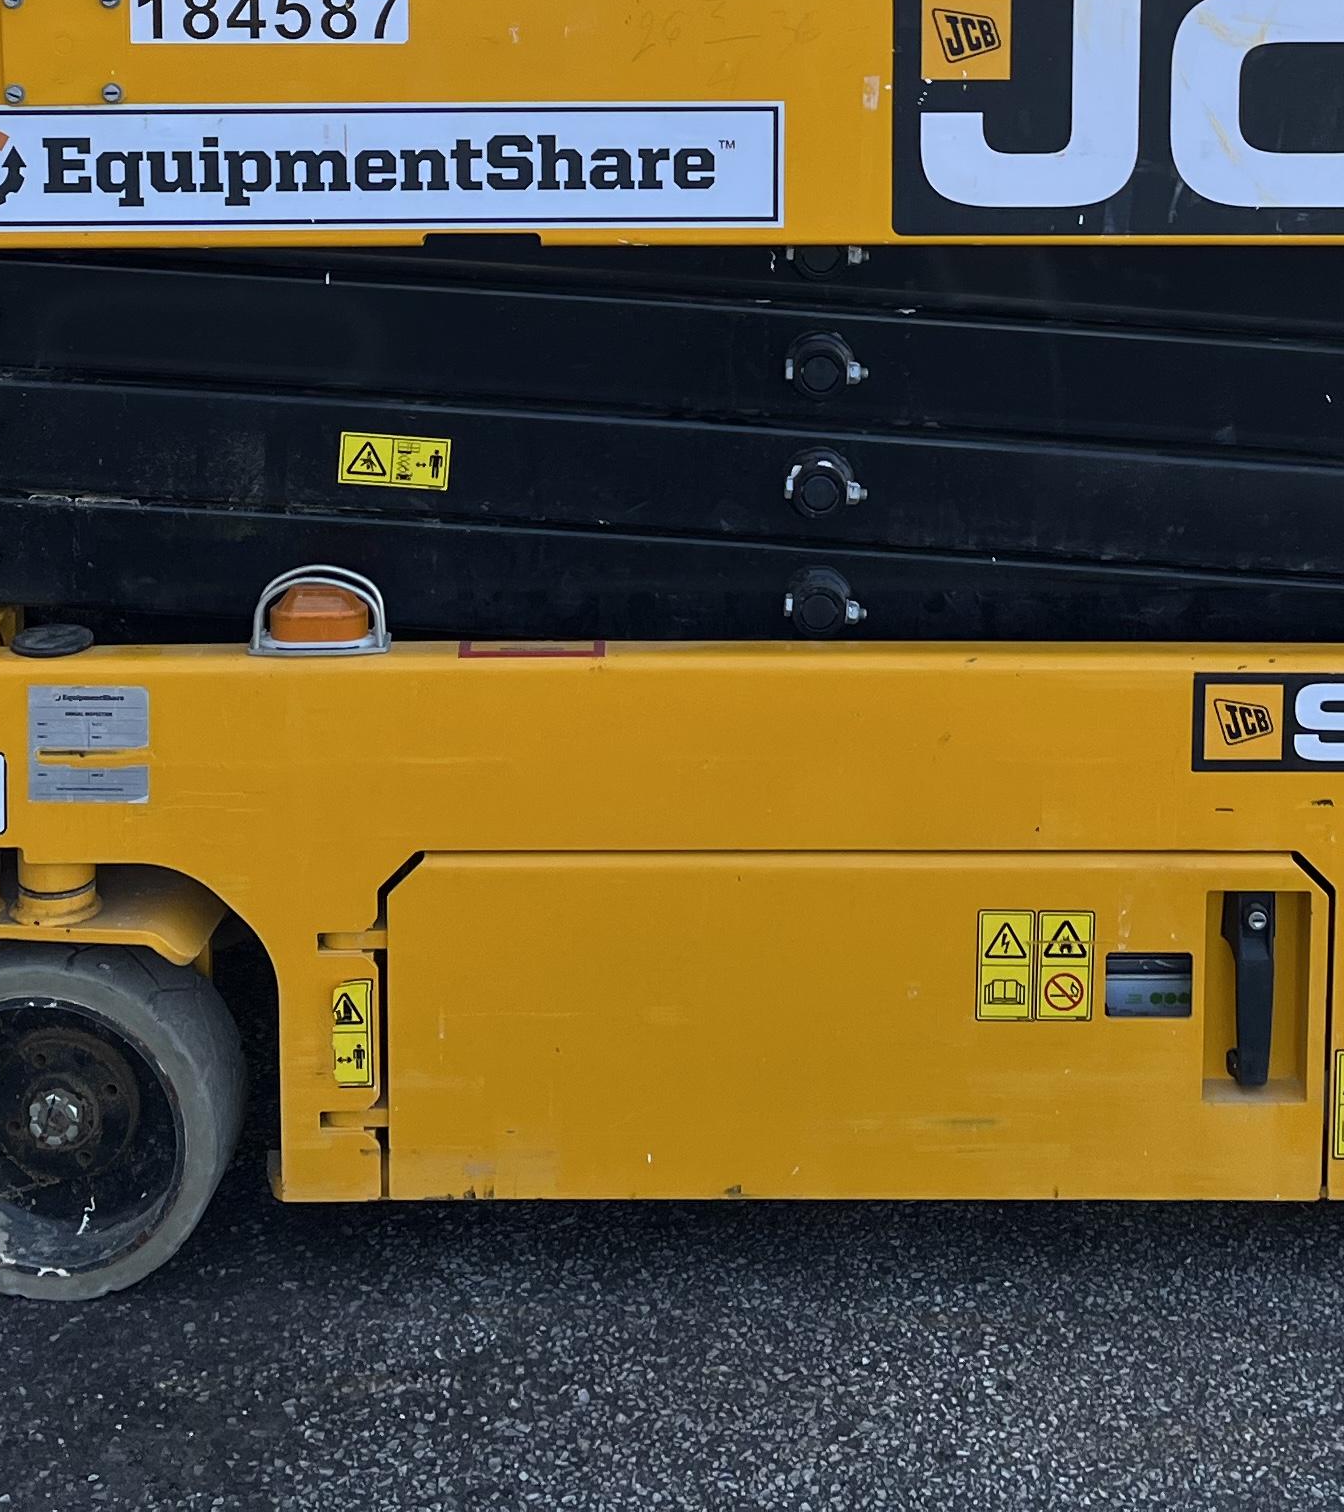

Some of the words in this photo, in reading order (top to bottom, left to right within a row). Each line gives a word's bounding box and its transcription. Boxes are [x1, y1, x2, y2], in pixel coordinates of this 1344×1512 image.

[943, 14, 996, 57] JCB
[41, 134, 716, 208] EquipmentShare
[1224, 703, 1270, 740] JCB
